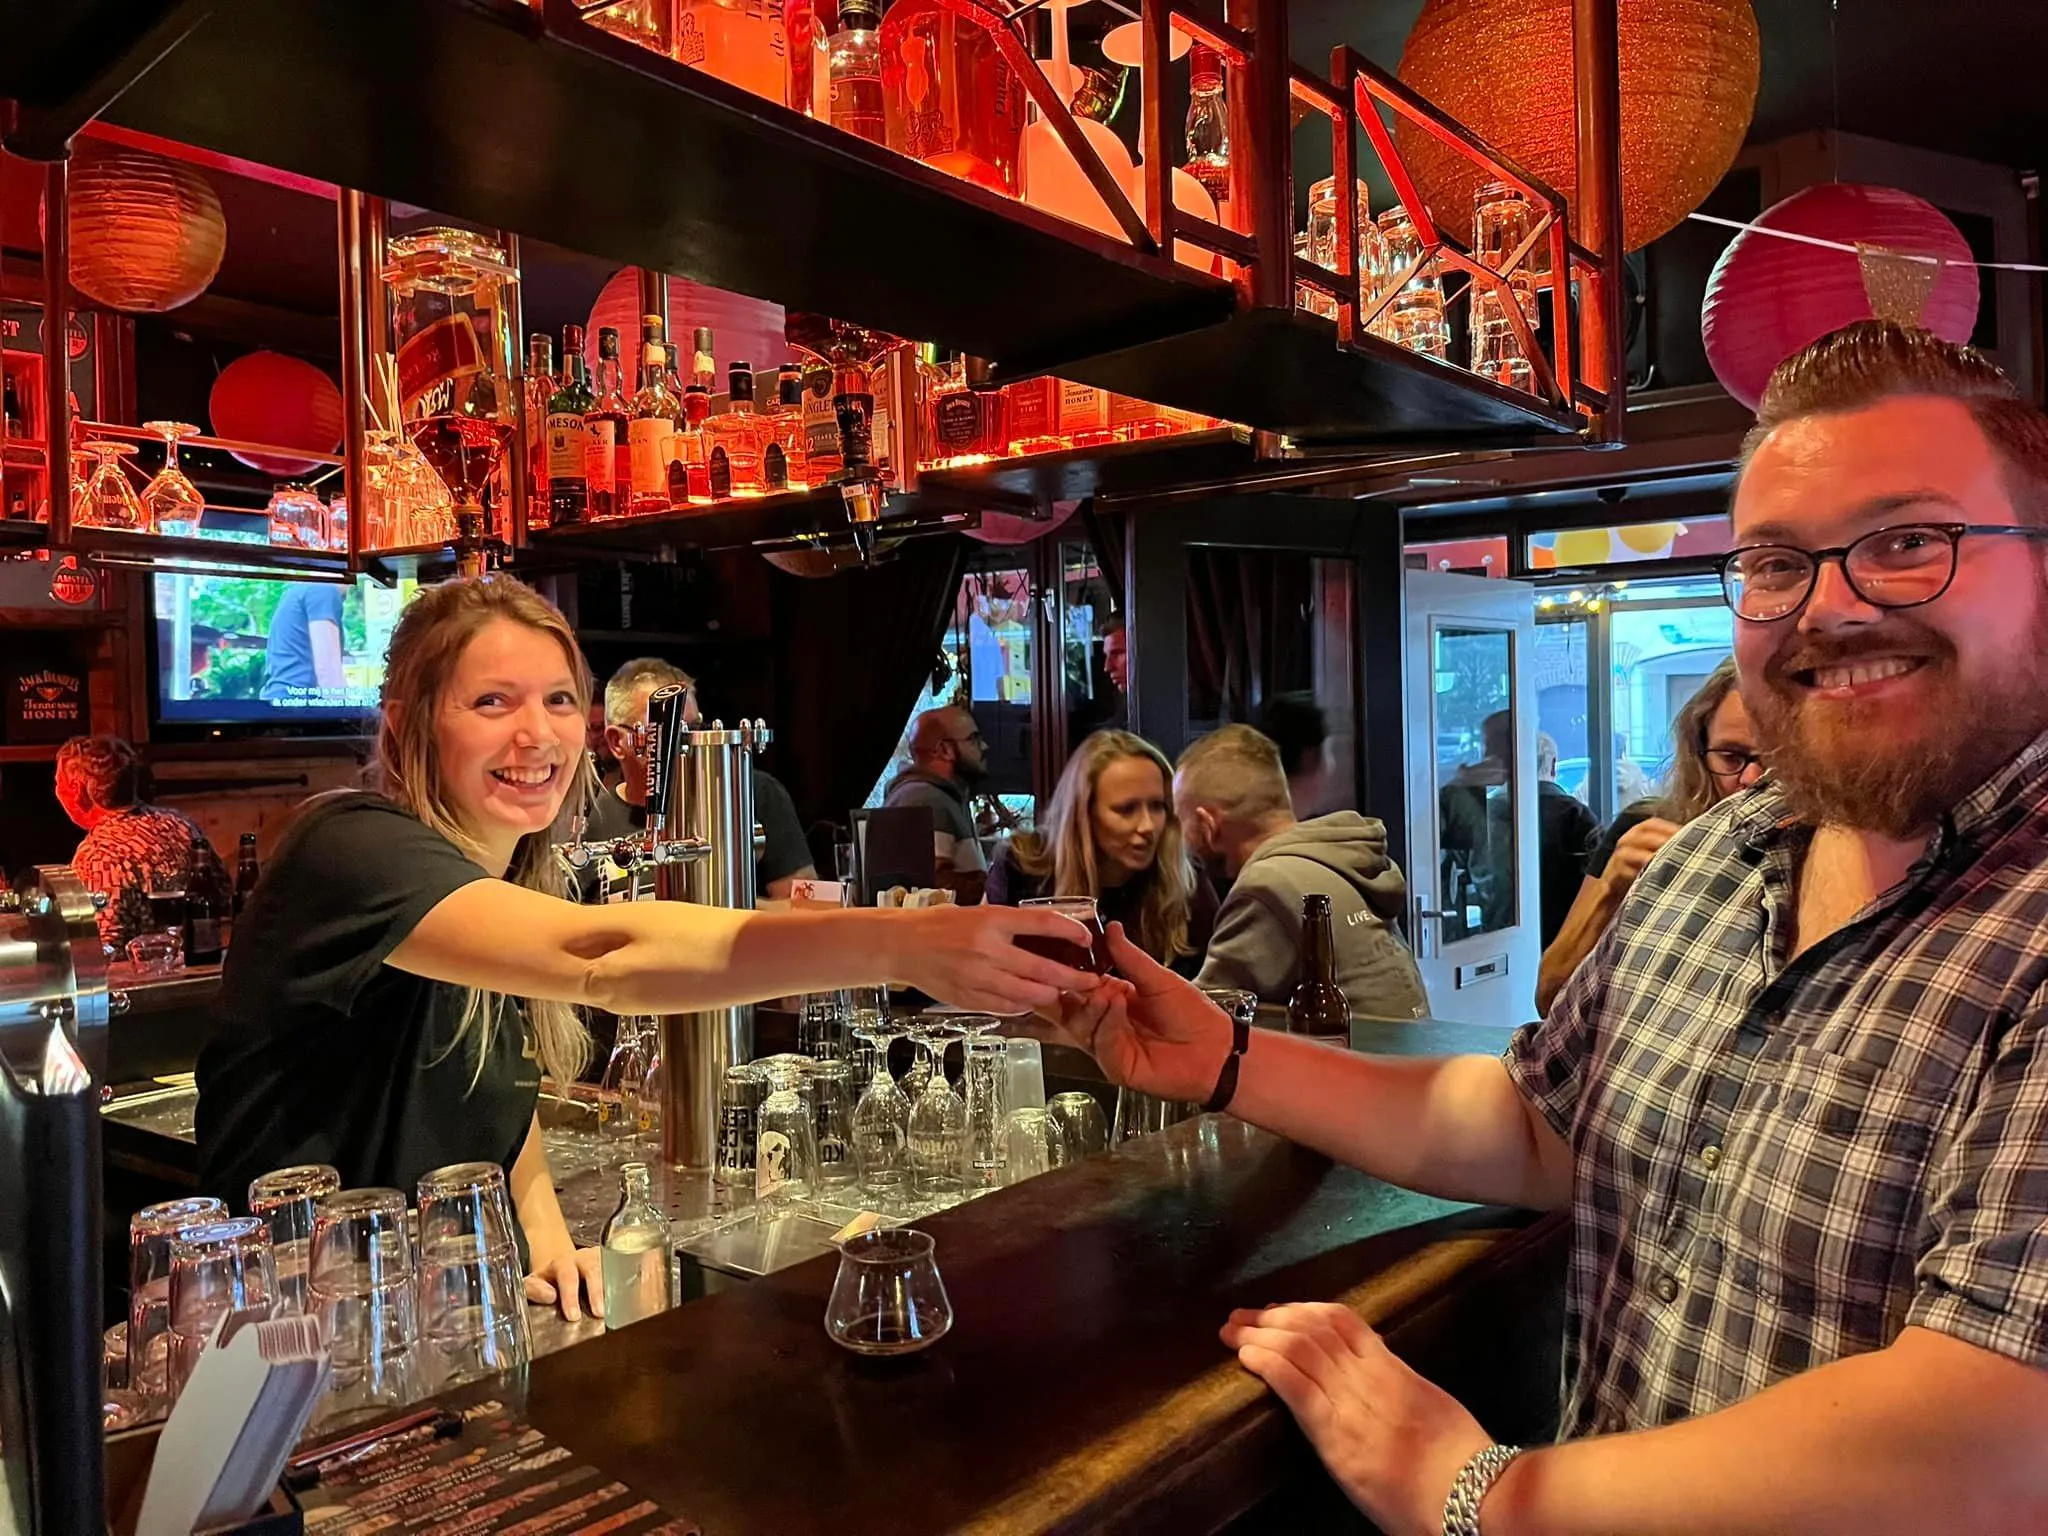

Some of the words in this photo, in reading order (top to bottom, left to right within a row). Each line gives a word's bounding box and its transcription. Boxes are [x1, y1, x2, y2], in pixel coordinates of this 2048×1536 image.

[1065, 394, 1095, 405] HONEY
[22, 710, 79, 720] HONEY
[646, 722, 657, 797] KOMPAAN
[1346, 909, 1372, 927] LIVE
